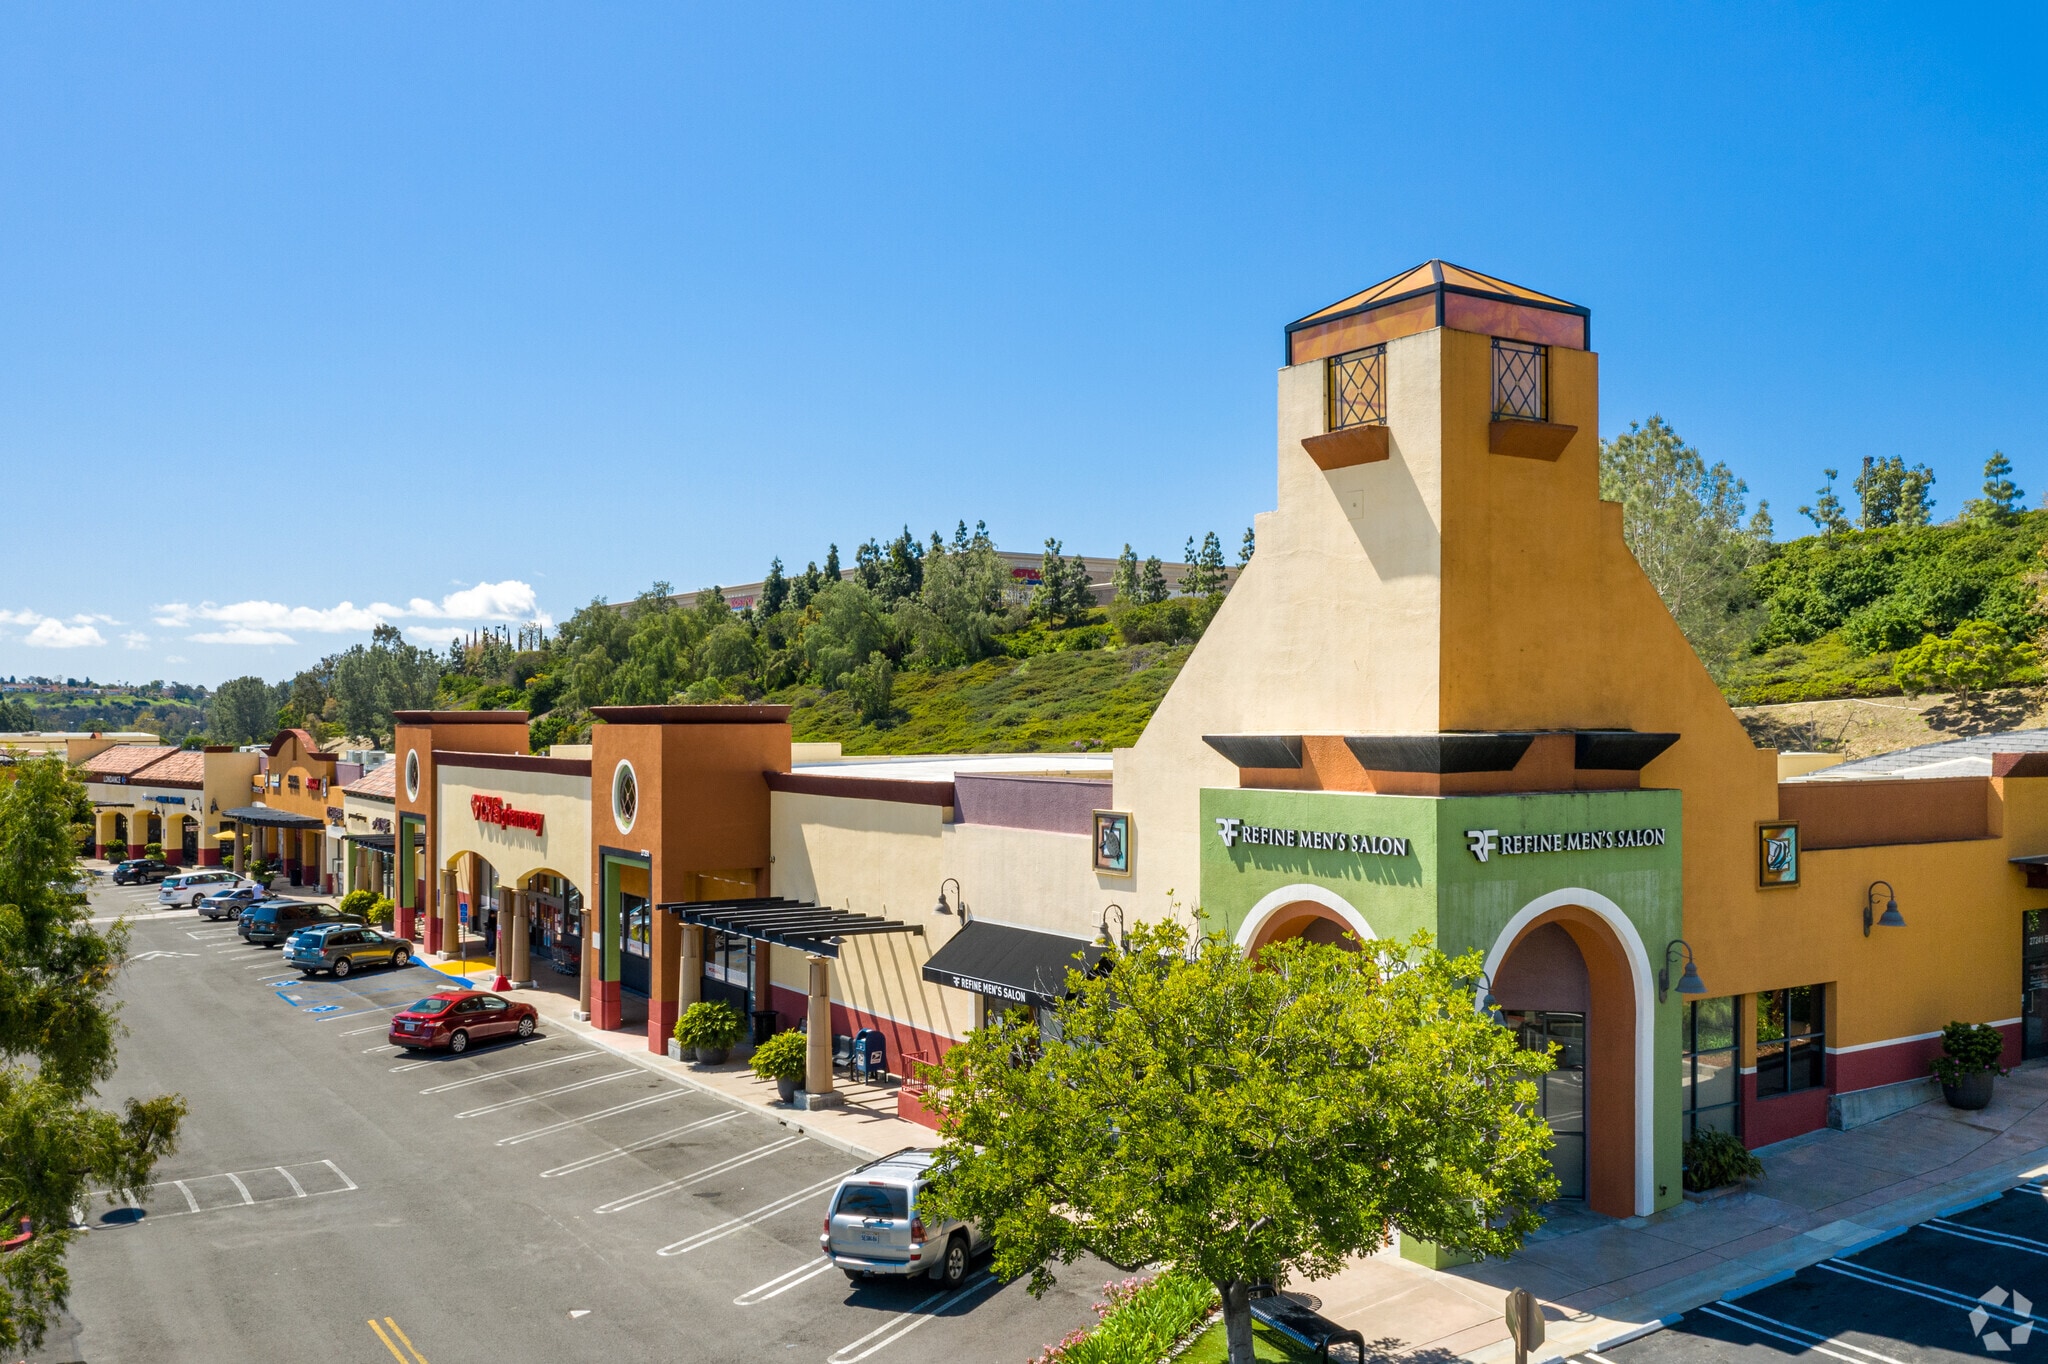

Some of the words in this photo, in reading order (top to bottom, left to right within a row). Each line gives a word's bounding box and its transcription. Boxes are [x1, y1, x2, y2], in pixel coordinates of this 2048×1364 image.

[480, 795, 503, 824] CVS
[501, 803, 545, 836] pharmacy
[1242, 826, 1296, 847] REFINE
[1299, 831, 1347, 851] MEN'S
[1351, 834, 1408, 856] SALON
[1500, 834, 1562, 855] REFINE
[1566, 831, 1613, 851] MEN'S
[1617, 828, 1666, 847] SALON
[961, 978, 982, 992] REFINE
[982, 982, 1003, 997] MEN'S
[1003, 987, 1026, 1002] SALON
